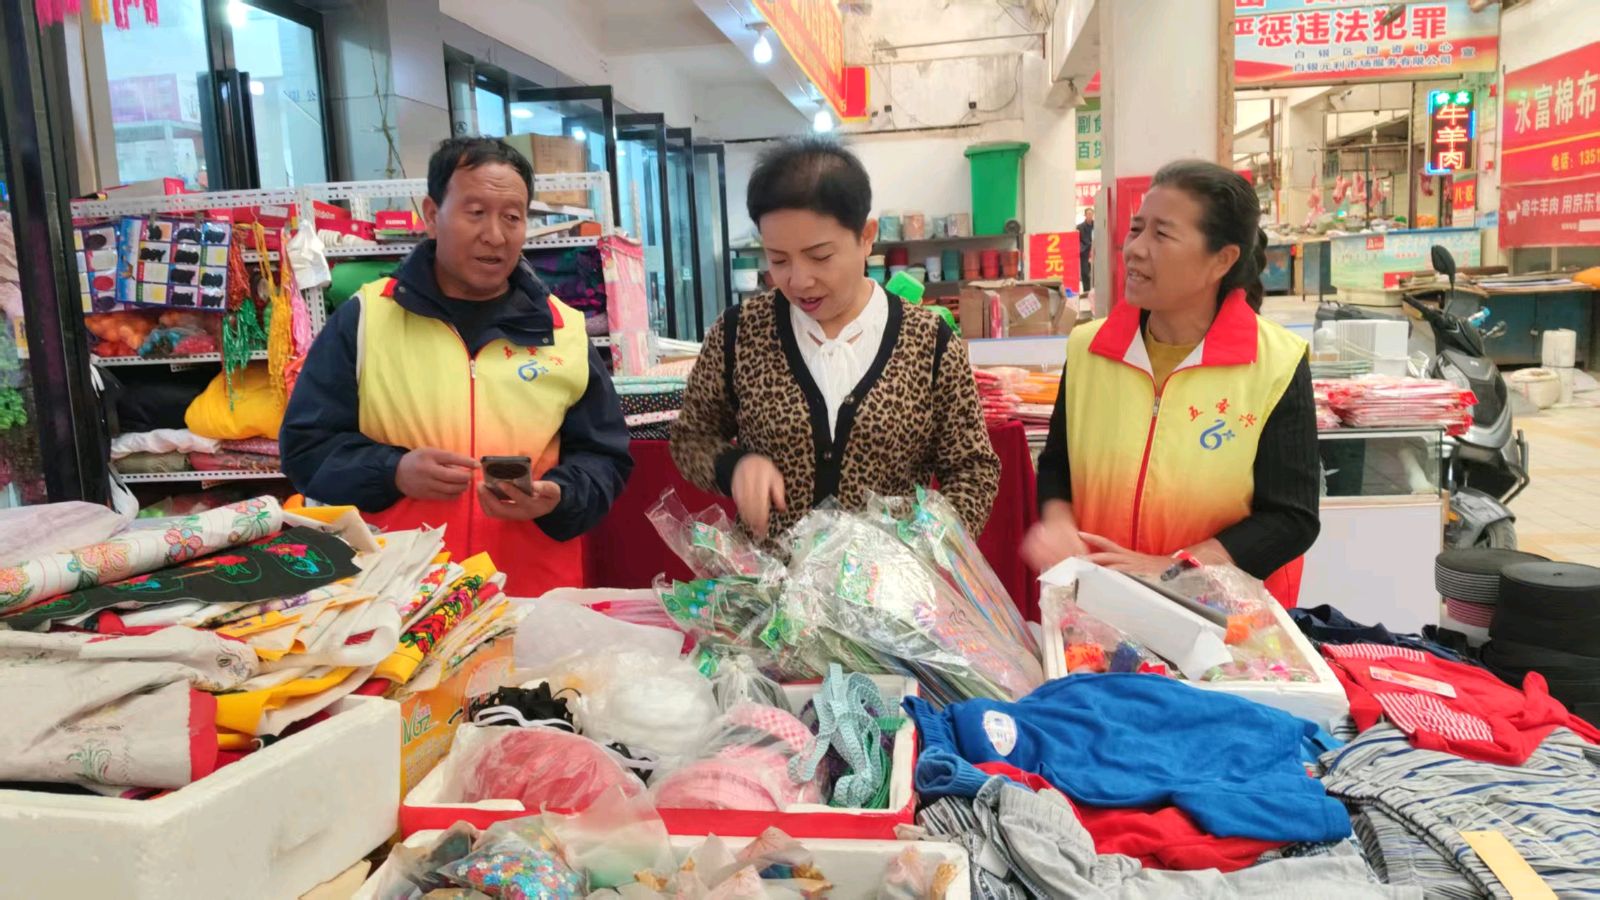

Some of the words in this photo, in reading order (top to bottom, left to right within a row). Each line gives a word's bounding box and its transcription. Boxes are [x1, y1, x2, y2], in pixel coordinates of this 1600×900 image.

[1514, 70, 1600, 134] 永富棉布
[1436, 103, 1468, 170] 牛羊肉
[1561, 191, 1600, 214] 用京东
[1045, 234, 1064, 280] 2元
